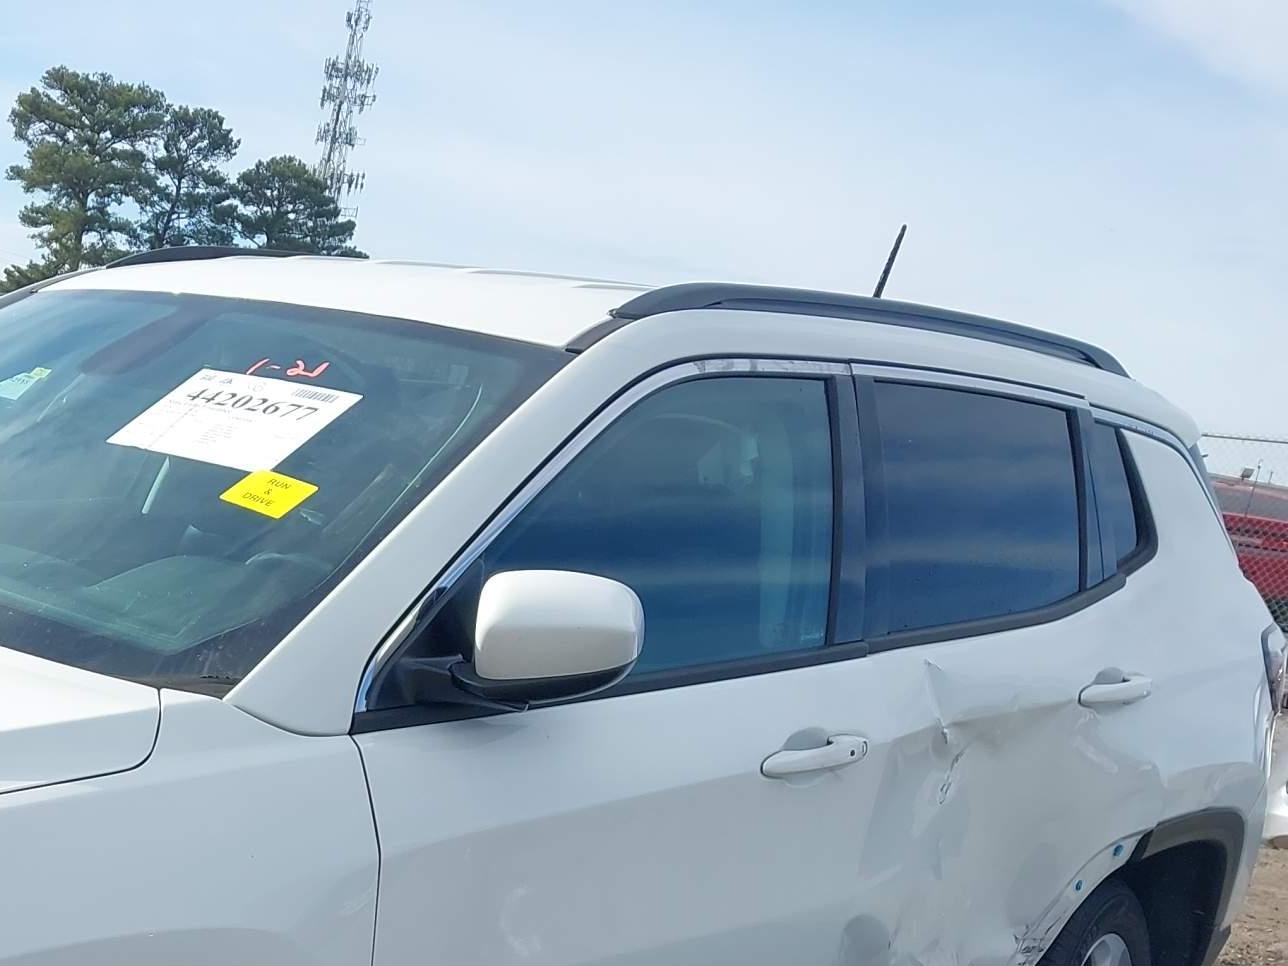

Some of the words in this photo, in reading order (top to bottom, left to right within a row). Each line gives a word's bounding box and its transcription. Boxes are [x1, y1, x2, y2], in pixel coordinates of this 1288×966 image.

[186, 387, 319, 421] 44202677
[267, 478, 292, 490] RUN
[263, 487, 273, 496] &
[242, 491, 275, 507] DRIVE
